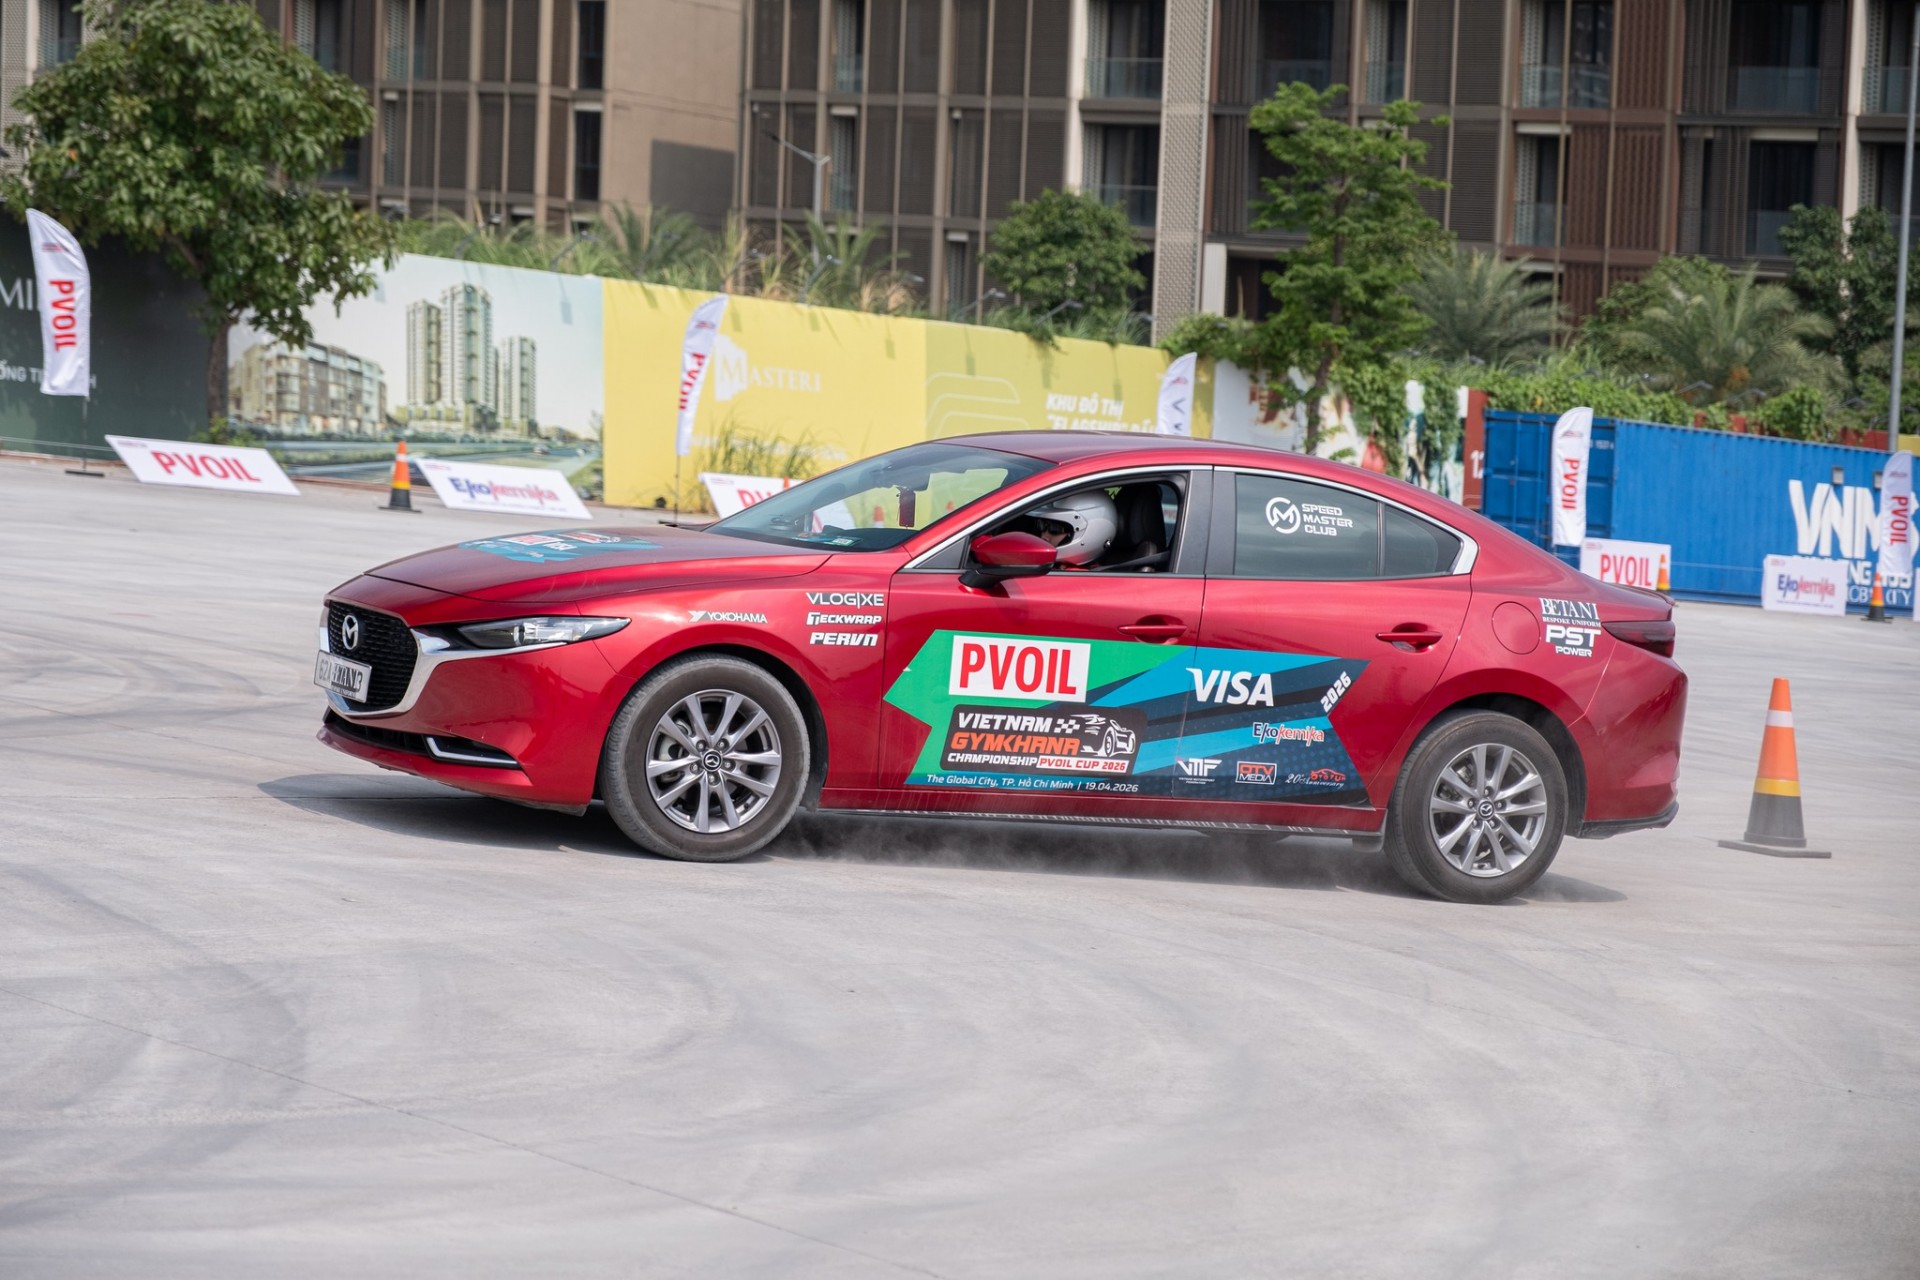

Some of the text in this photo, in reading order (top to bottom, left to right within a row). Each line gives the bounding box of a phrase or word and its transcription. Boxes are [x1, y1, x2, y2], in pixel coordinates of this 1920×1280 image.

[49, 280, 77, 352] PVOIL
[720, 352, 822, 394] MASTERI
[1046, 392, 1077, 412] KHU
[151, 451, 262, 483] PVOIL
[1302, 503, 1343, 516] SPEED
[1303, 514, 1353, 528] MASTER
[1890, 496, 1909, 546] PVOIL
[1304, 524, 1338, 537] CLUB
[1600, 553, 1653, 587] PVOIL
[707, 611, 768, 624] YOKOHAMA
[806, 612, 883, 626] TECKWRAP
[1539, 597, 1600, 620] BETANI
[1545, 624, 1602, 648] PST
[1555, 645, 1593, 658] POWER
[959, 642, 1077, 695] PVOIL
[1186, 667, 1275, 707] VISA
[1320, 671, 1352, 713] 2026
[958, 712, 1053, 734] VIETNAM
[1253, 721, 1325, 747] Ekokemika
[950, 731, 1081, 756] GYMKHANA
[947, 752, 1126, 772] CHAMPIONSHIP PVOIL CUP 2026
[927, 774, 944, 784] The
[946, 775, 975, 786] Global
[978, 776, 999, 788] City,
[1001, 779, 1016, 788] TP.
[1033, 779, 1048, 790] Chí
[1050, 780, 1074, 790] Minh
[1085, 782, 1139, 793] 19.04.2026
[1239, 773, 1273, 784] MEDIA
